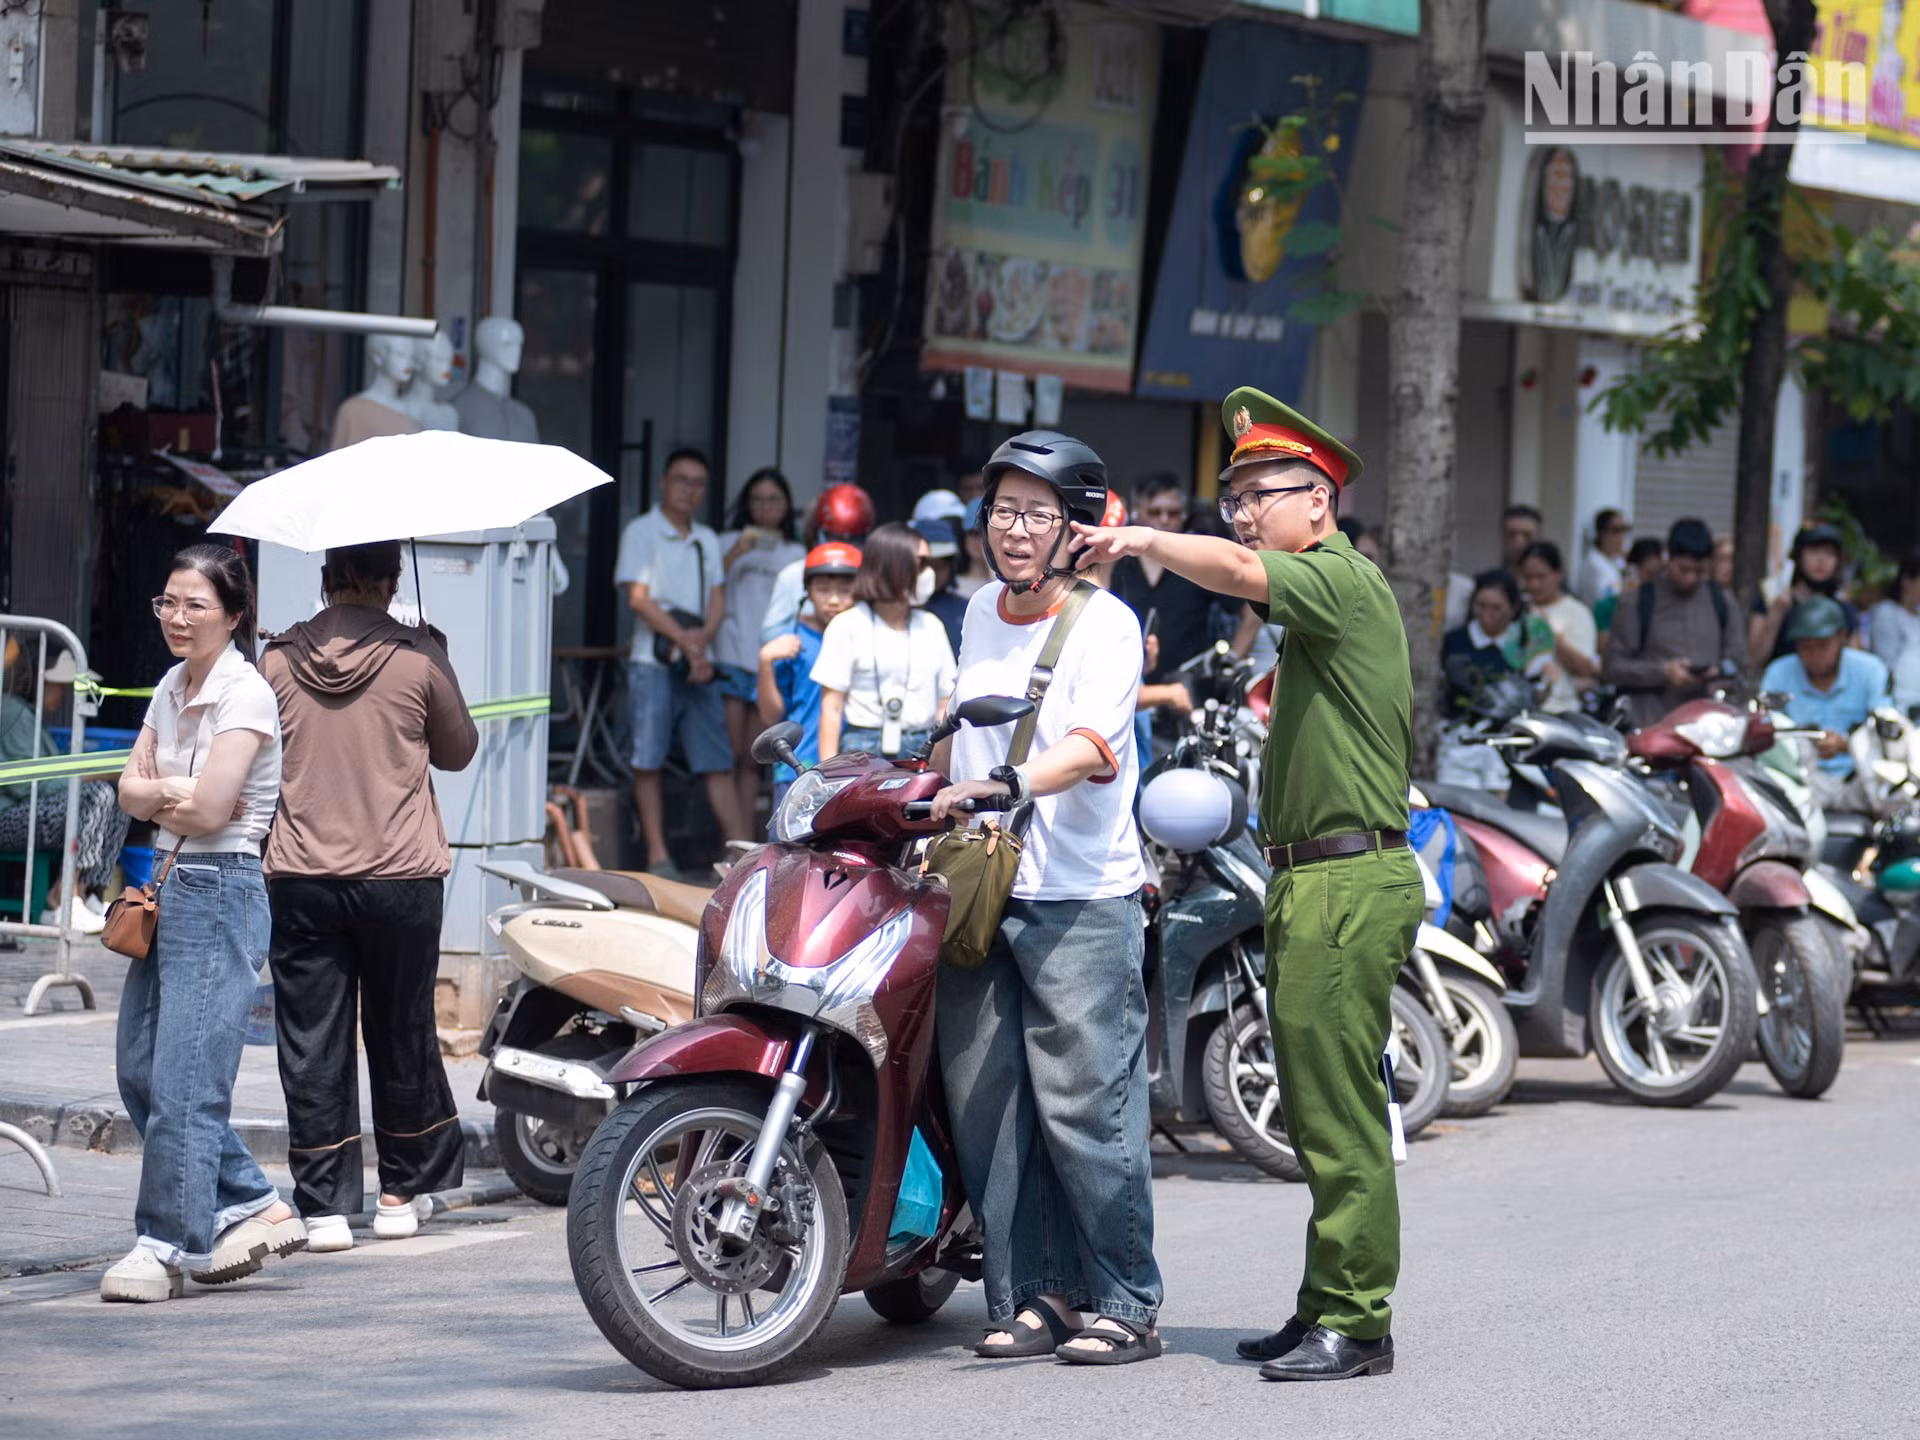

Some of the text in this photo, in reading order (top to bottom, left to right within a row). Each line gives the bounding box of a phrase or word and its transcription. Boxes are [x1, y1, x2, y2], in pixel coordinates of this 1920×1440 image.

[953, 136, 1026, 208] Bánh
[832, 851, 867, 864] HONDA
[1167, 912, 1203, 924] HONDA
